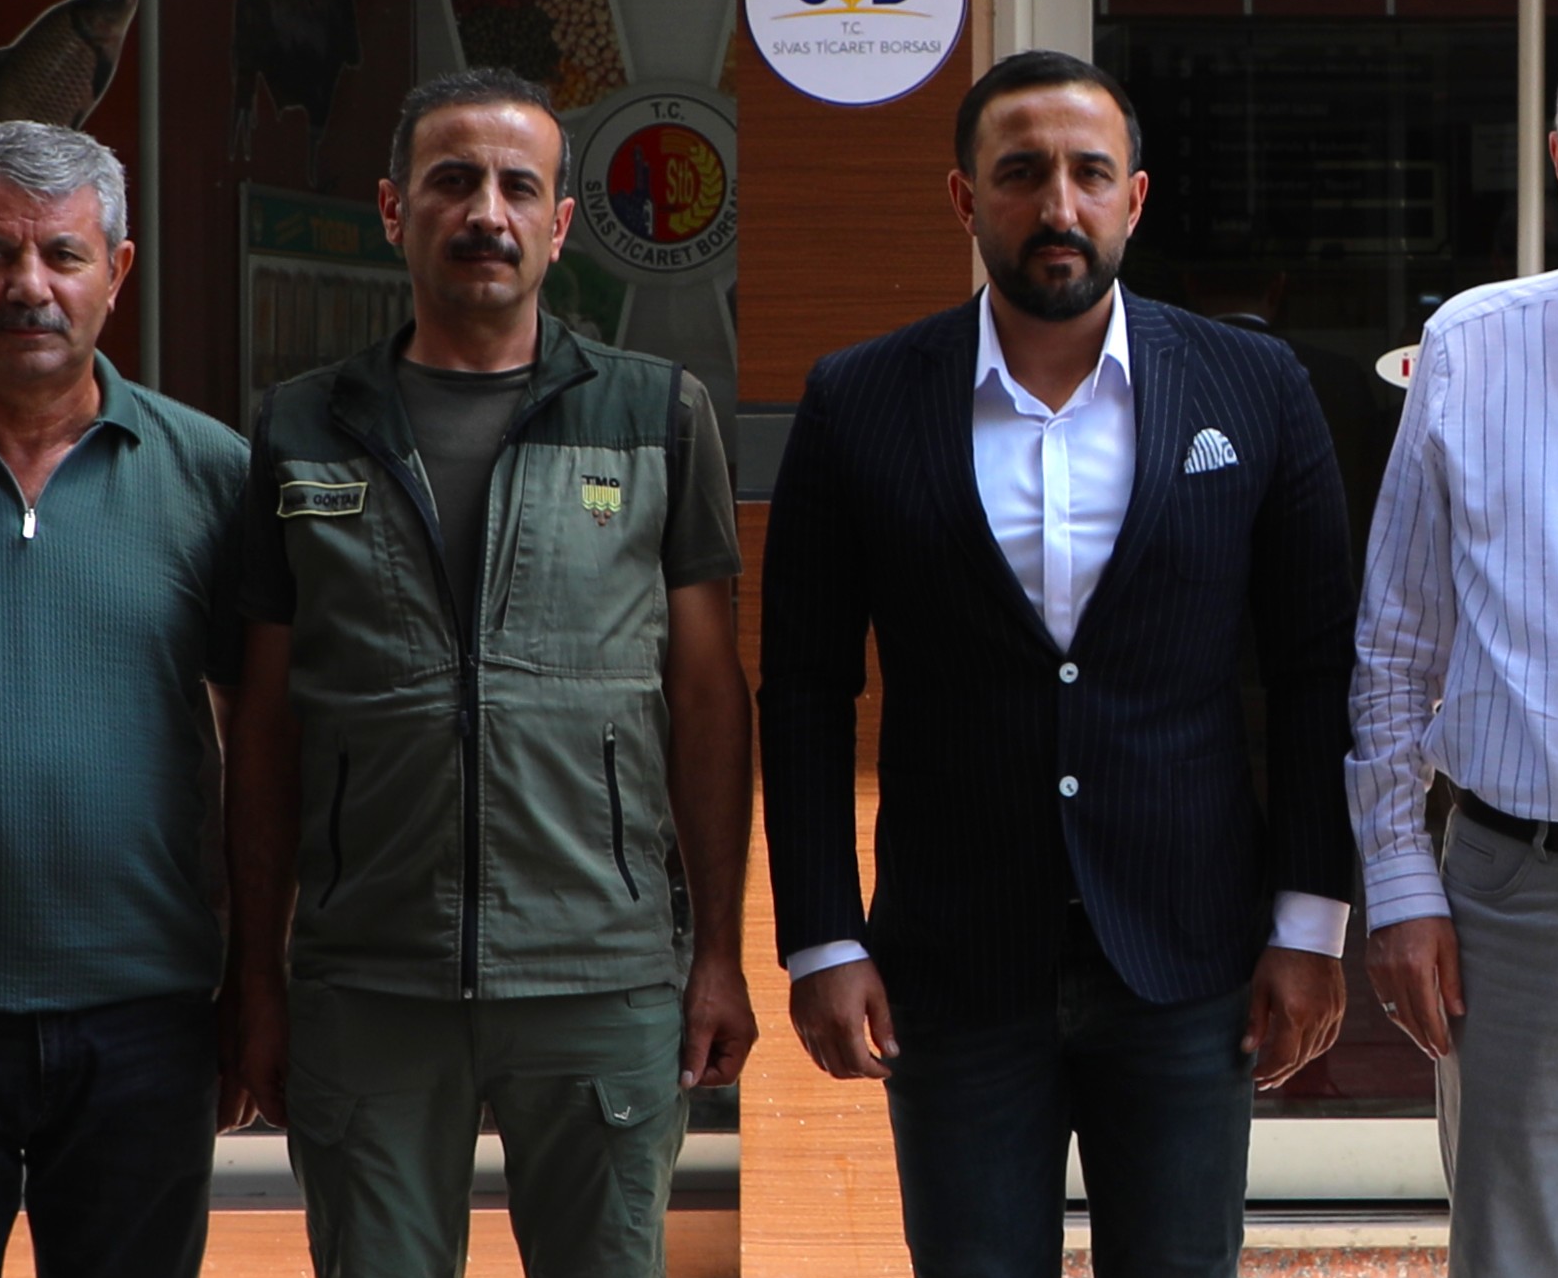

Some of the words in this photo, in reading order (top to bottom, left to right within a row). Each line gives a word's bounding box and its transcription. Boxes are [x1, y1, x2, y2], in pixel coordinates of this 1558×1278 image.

[841, 21, 864, 35] T.C.
[773, 39, 811, 55] SİVAS
[817, 38, 875, 54] TİCARET
[880, 39, 941, 54] BORSASI
[650, 101, 685, 120] T.C.
[585, 179, 616, 235] SİVAS
[613, 234, 694, 265] TİCARET
[581, 474, 621, 488] TMO
